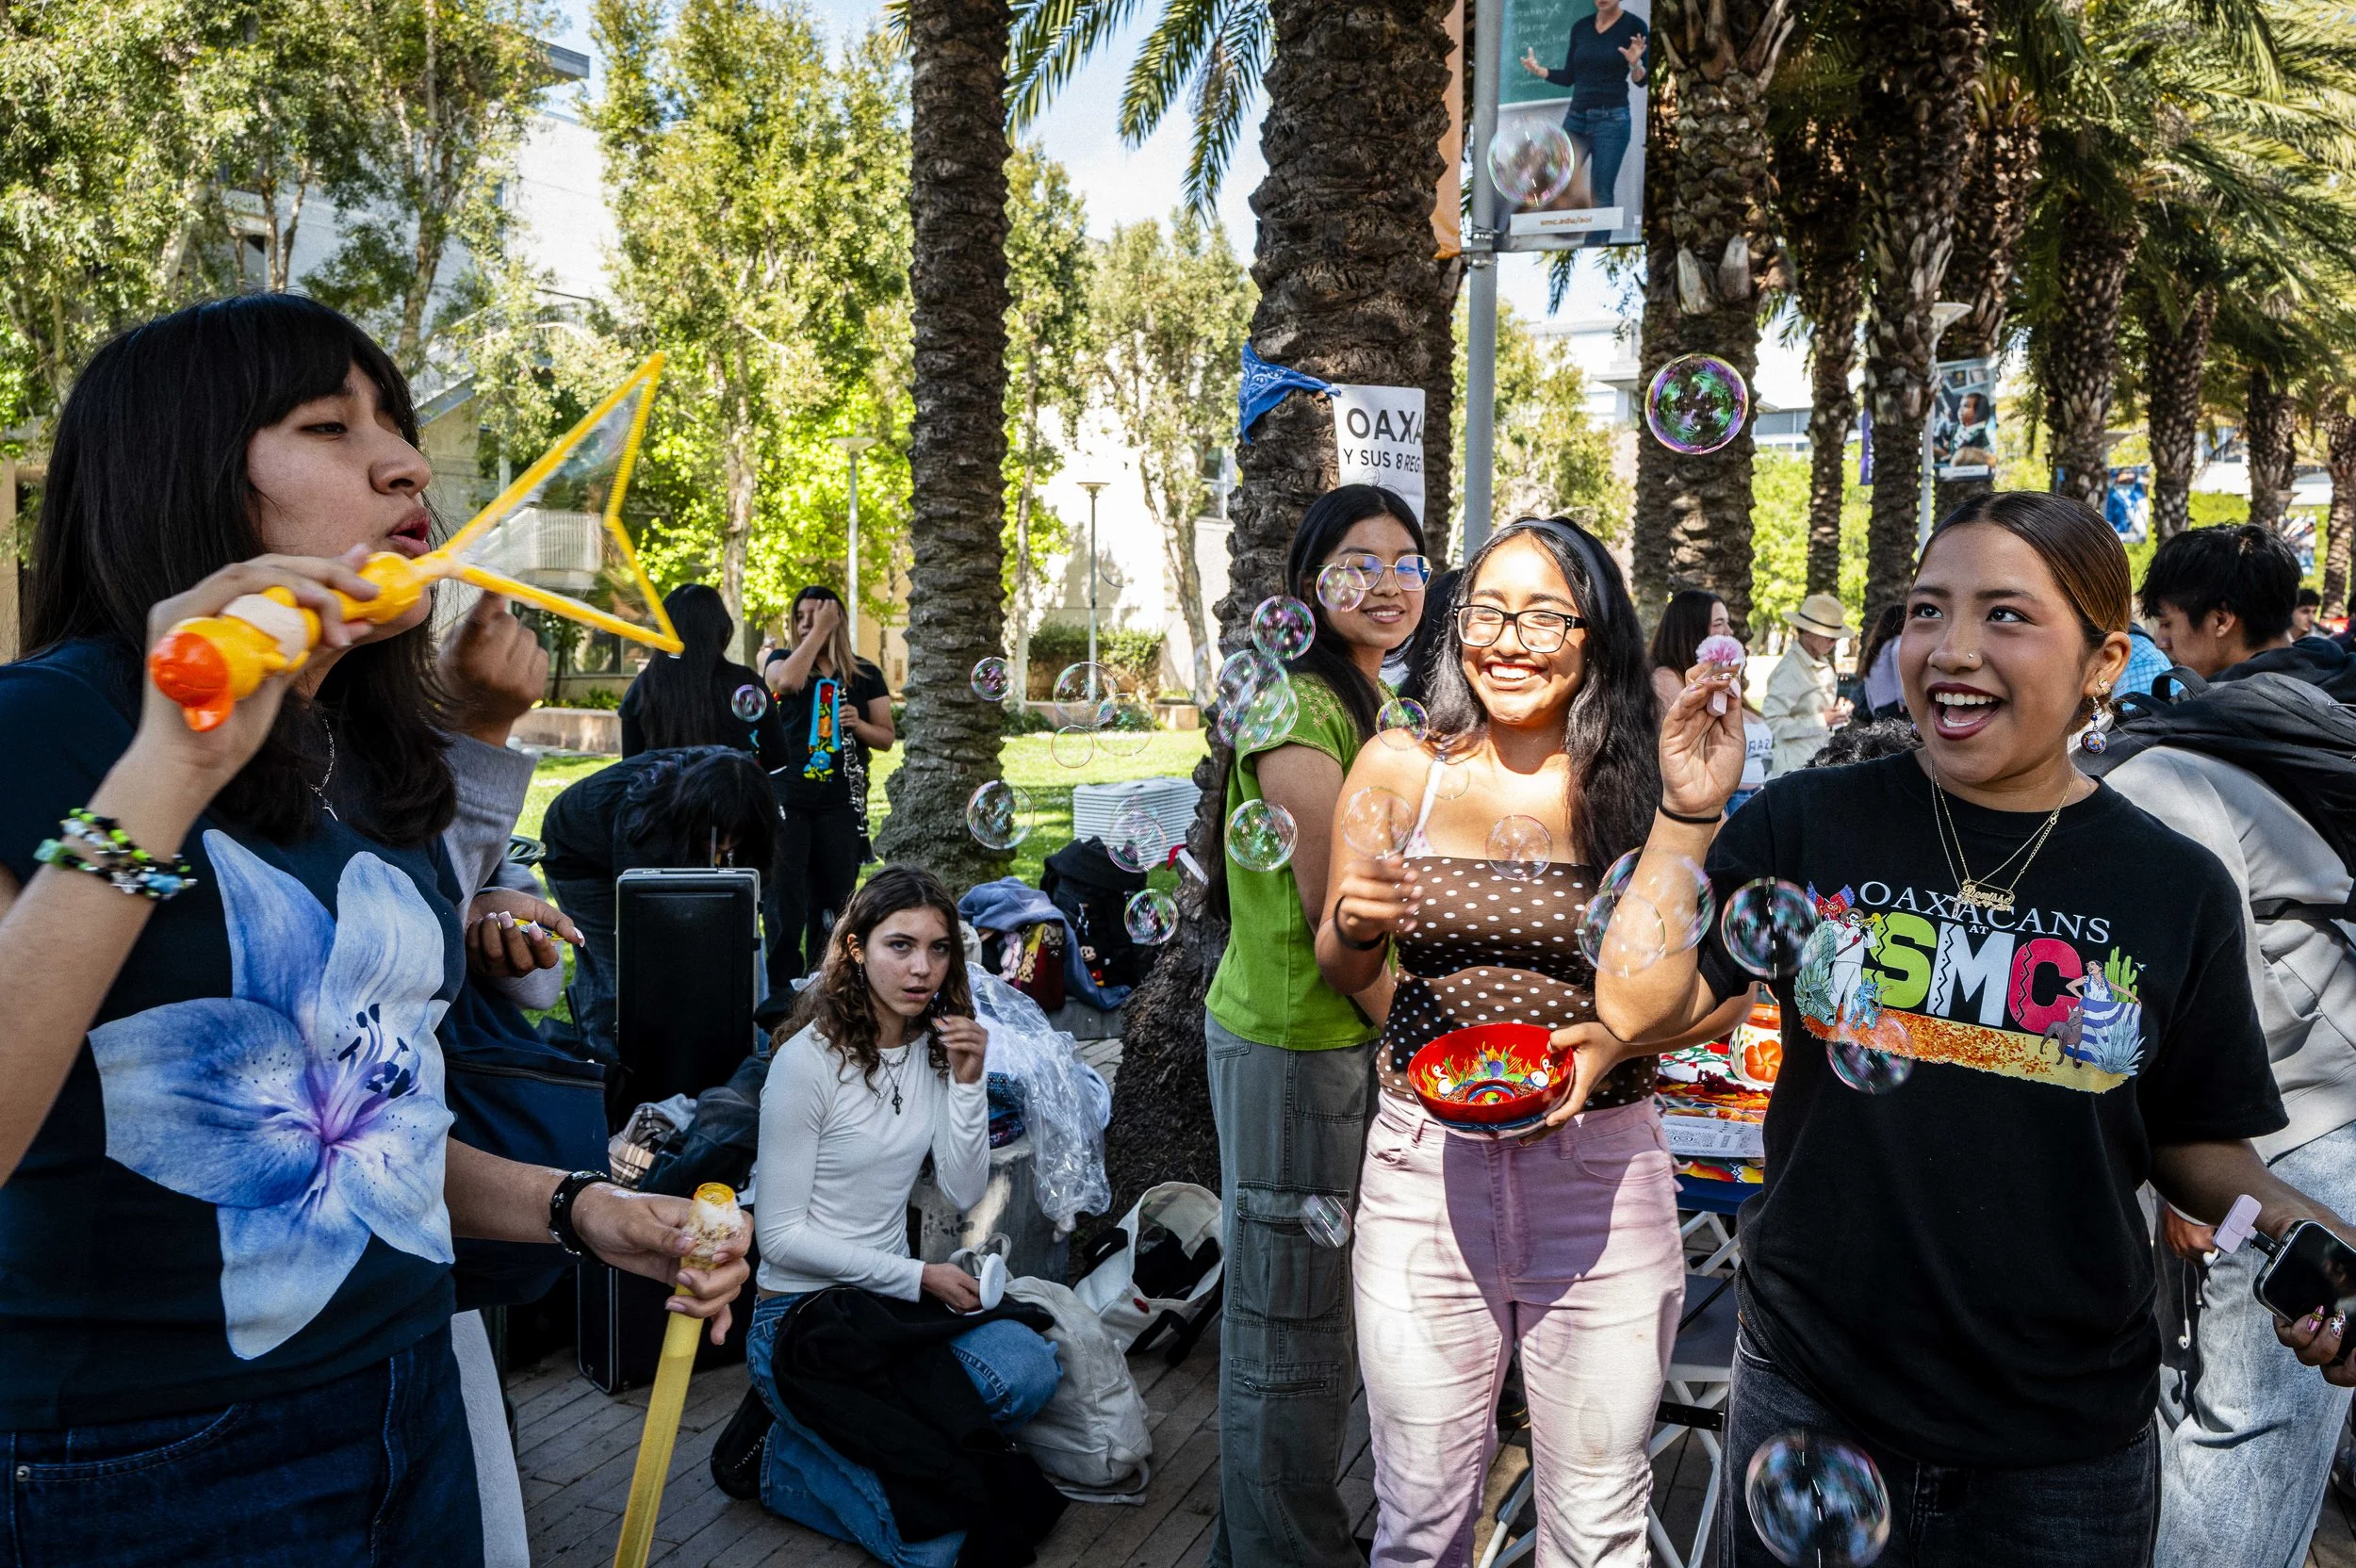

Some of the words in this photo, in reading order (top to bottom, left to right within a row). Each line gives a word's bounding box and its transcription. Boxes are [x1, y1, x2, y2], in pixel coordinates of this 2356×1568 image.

[1343, 449, 1353, 465] Y
[1360, 449, 1391, 467] SUS
[1396, 452, 1403, 470] 8
[1859, 881, 2111, 943] OAXACANS
[1968, 924, 1989, 935] AT
[1862, 912, 2083, 1035] SMC
